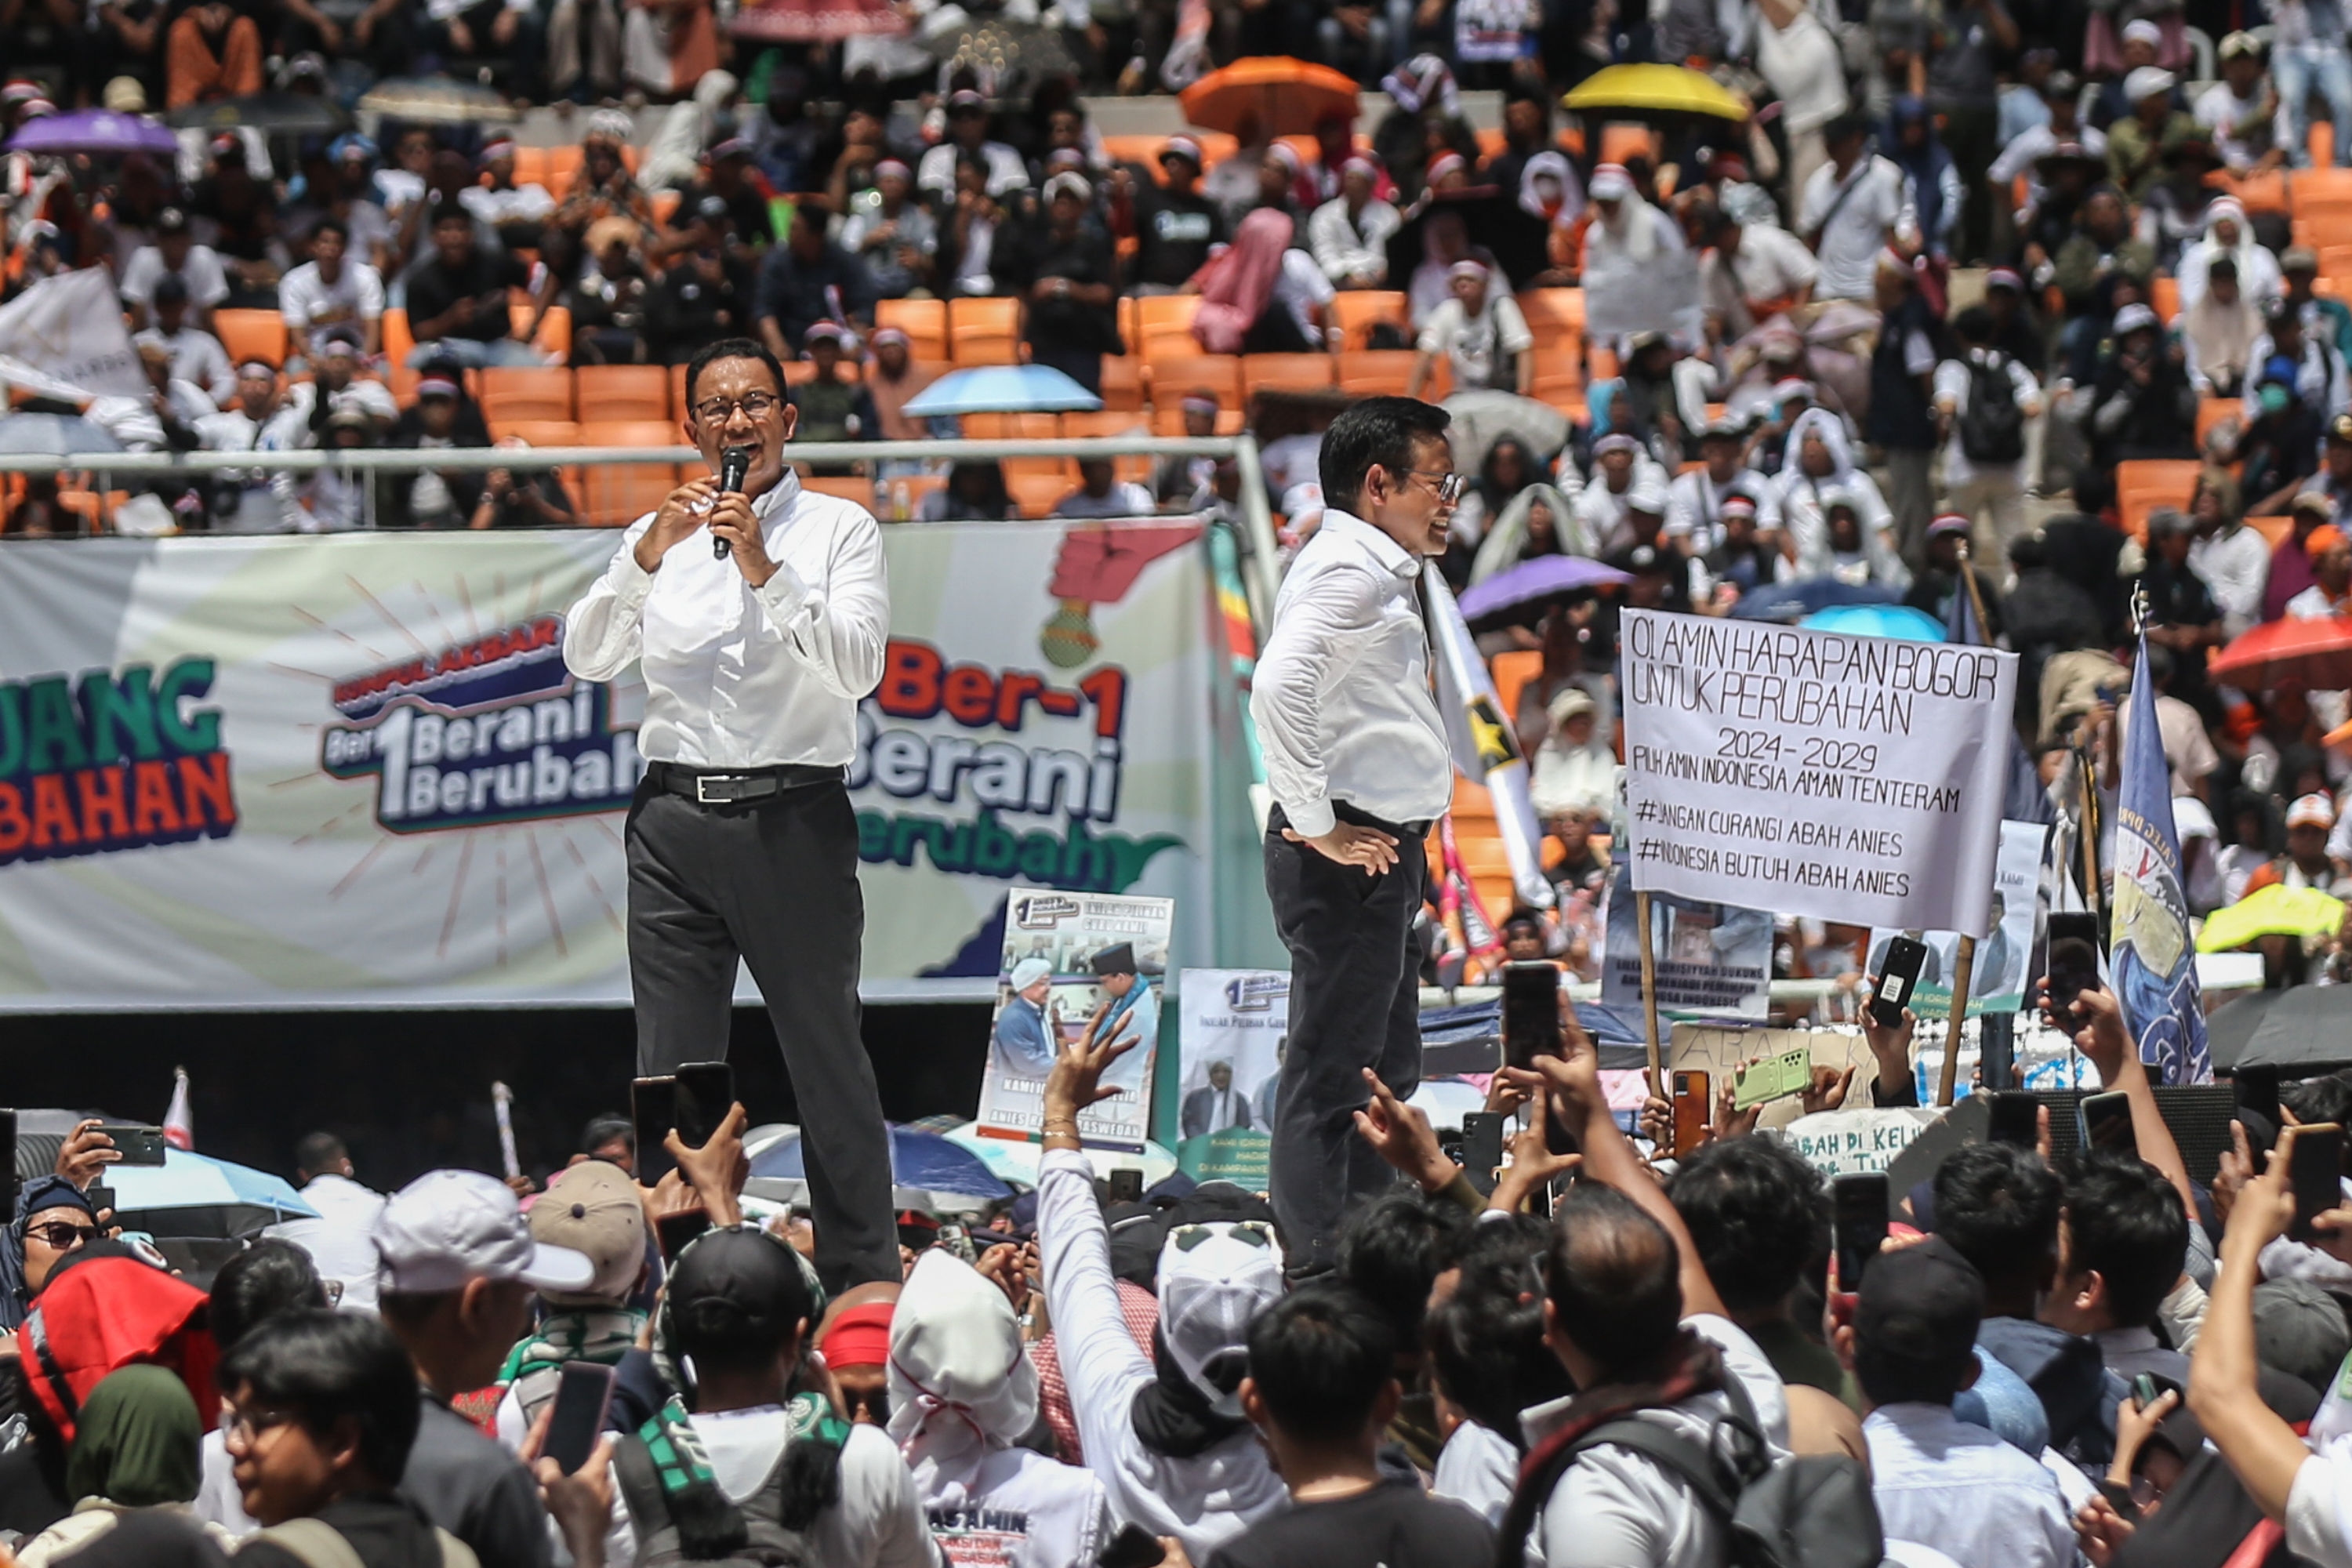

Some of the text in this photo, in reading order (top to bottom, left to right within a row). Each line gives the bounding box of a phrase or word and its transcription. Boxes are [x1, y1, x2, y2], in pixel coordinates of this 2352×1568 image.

[1632, 660, 1913, 735] UNTUK PERUBAHAN
[1661, 620, 1728, 669] AMIN
[1732, 628, 1889, 687] HARAPAN
[1892, 644, 1998, 701] BOGOR
[412, 679, 594, 765] Berani
[1664, 750, 1698, 781] AMIN
[1701, 757, 1788, 793] INDONESIA
[1792, 769, 1844, 800] AMAN
[1849, 775, 1961, 813] TENTERAM
[855, 804, 1112, 886] erubah
[1708, 811, 1783, 842] CURANGI
[1787, 820, 1842, 849] ABAH
[1846, 828, 1904, 858] ANIES
[1725, 851, 1790, 882] BUTUH
[1794, 861, 1848, 891] ABAH
[1852, 869, 1911, 898] ANIES
